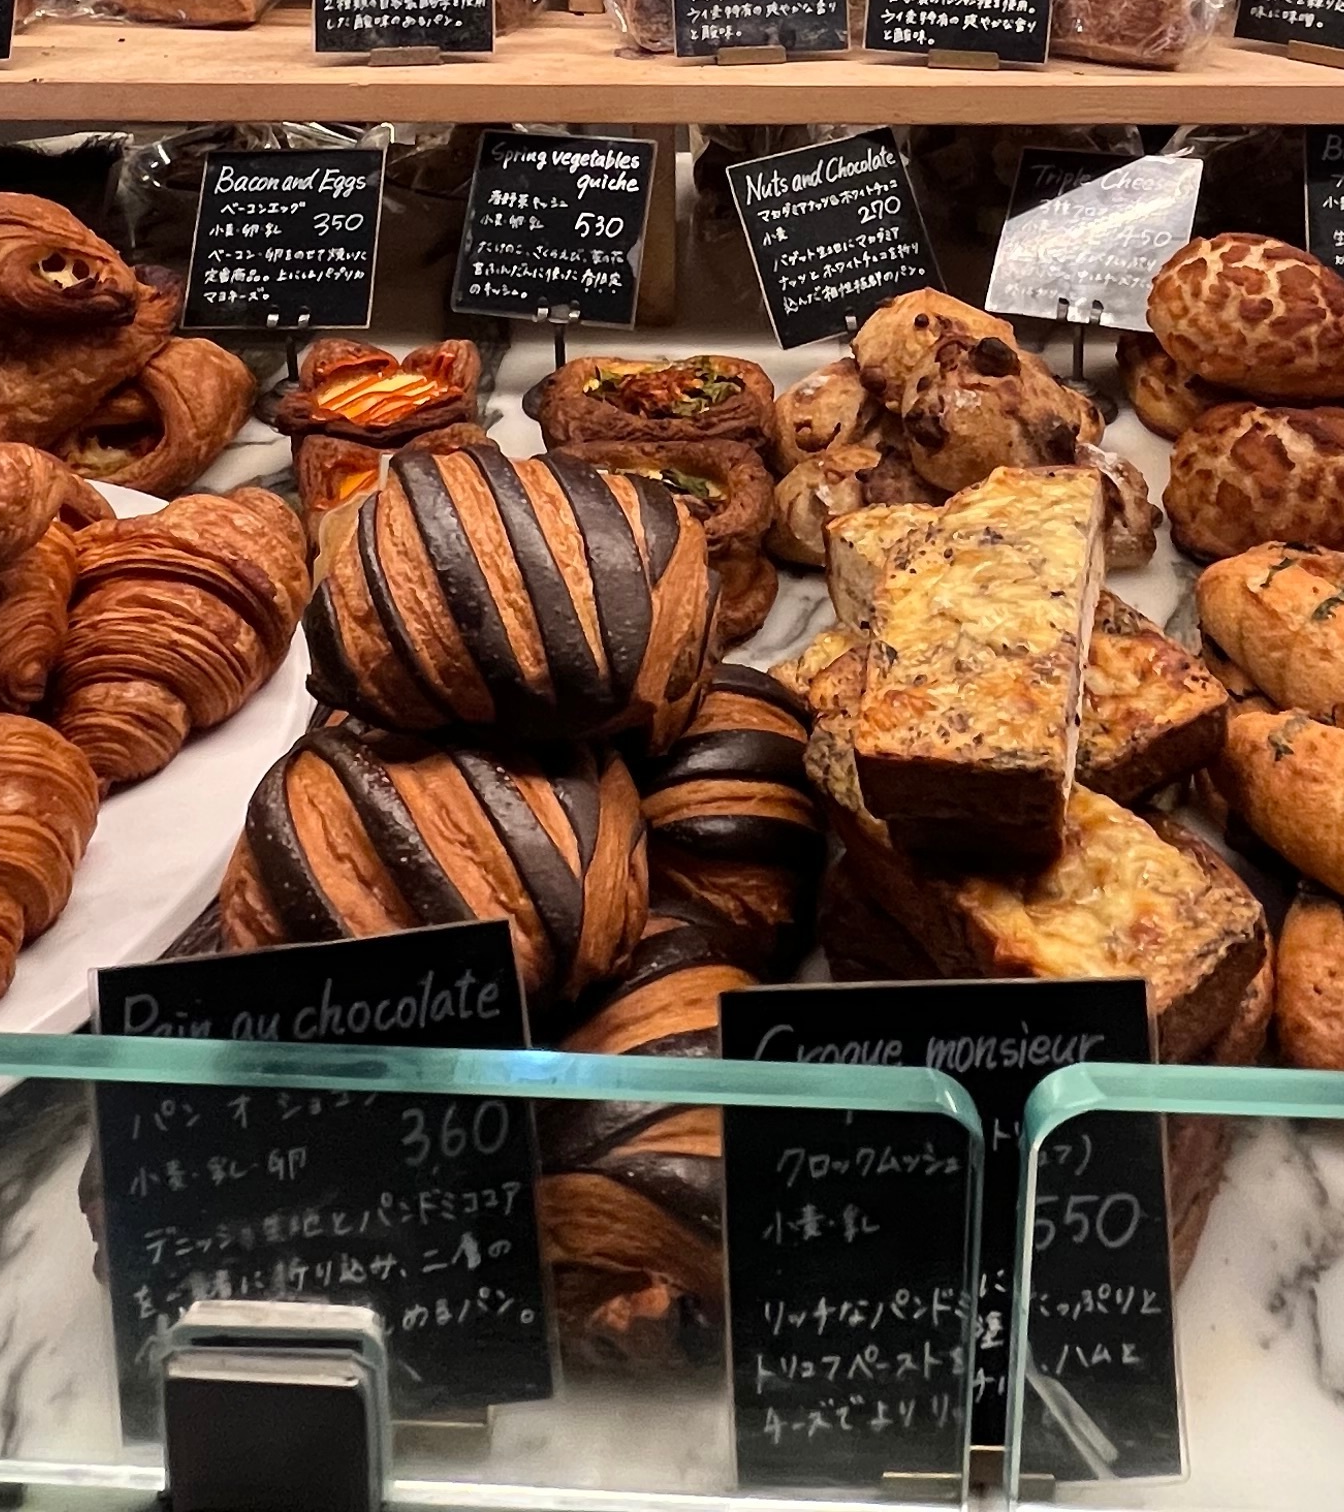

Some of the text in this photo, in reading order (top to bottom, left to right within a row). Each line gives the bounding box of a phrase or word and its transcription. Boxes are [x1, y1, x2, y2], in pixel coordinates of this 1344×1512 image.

[492, 141, 640, 174] Spring vegetables
[214, 166, 367, 199] Bacon and Eggs
[576, 171, 640, 200] quiche
[745, 145, 896, 205] Nuts and Chocolate
[1031, 164, 1091, 196] Triple
[313, 213, 364, 236] 350
[575, 212, 624, 238] 530
[857, 196, 901, 225] 270
[1114, 226, 1173, 248] 450
[293, 970, 501, 1040] chocolate
[926, 1021, 1105, 1072] monsieur
[401, 1100, 511, 1167] 360
